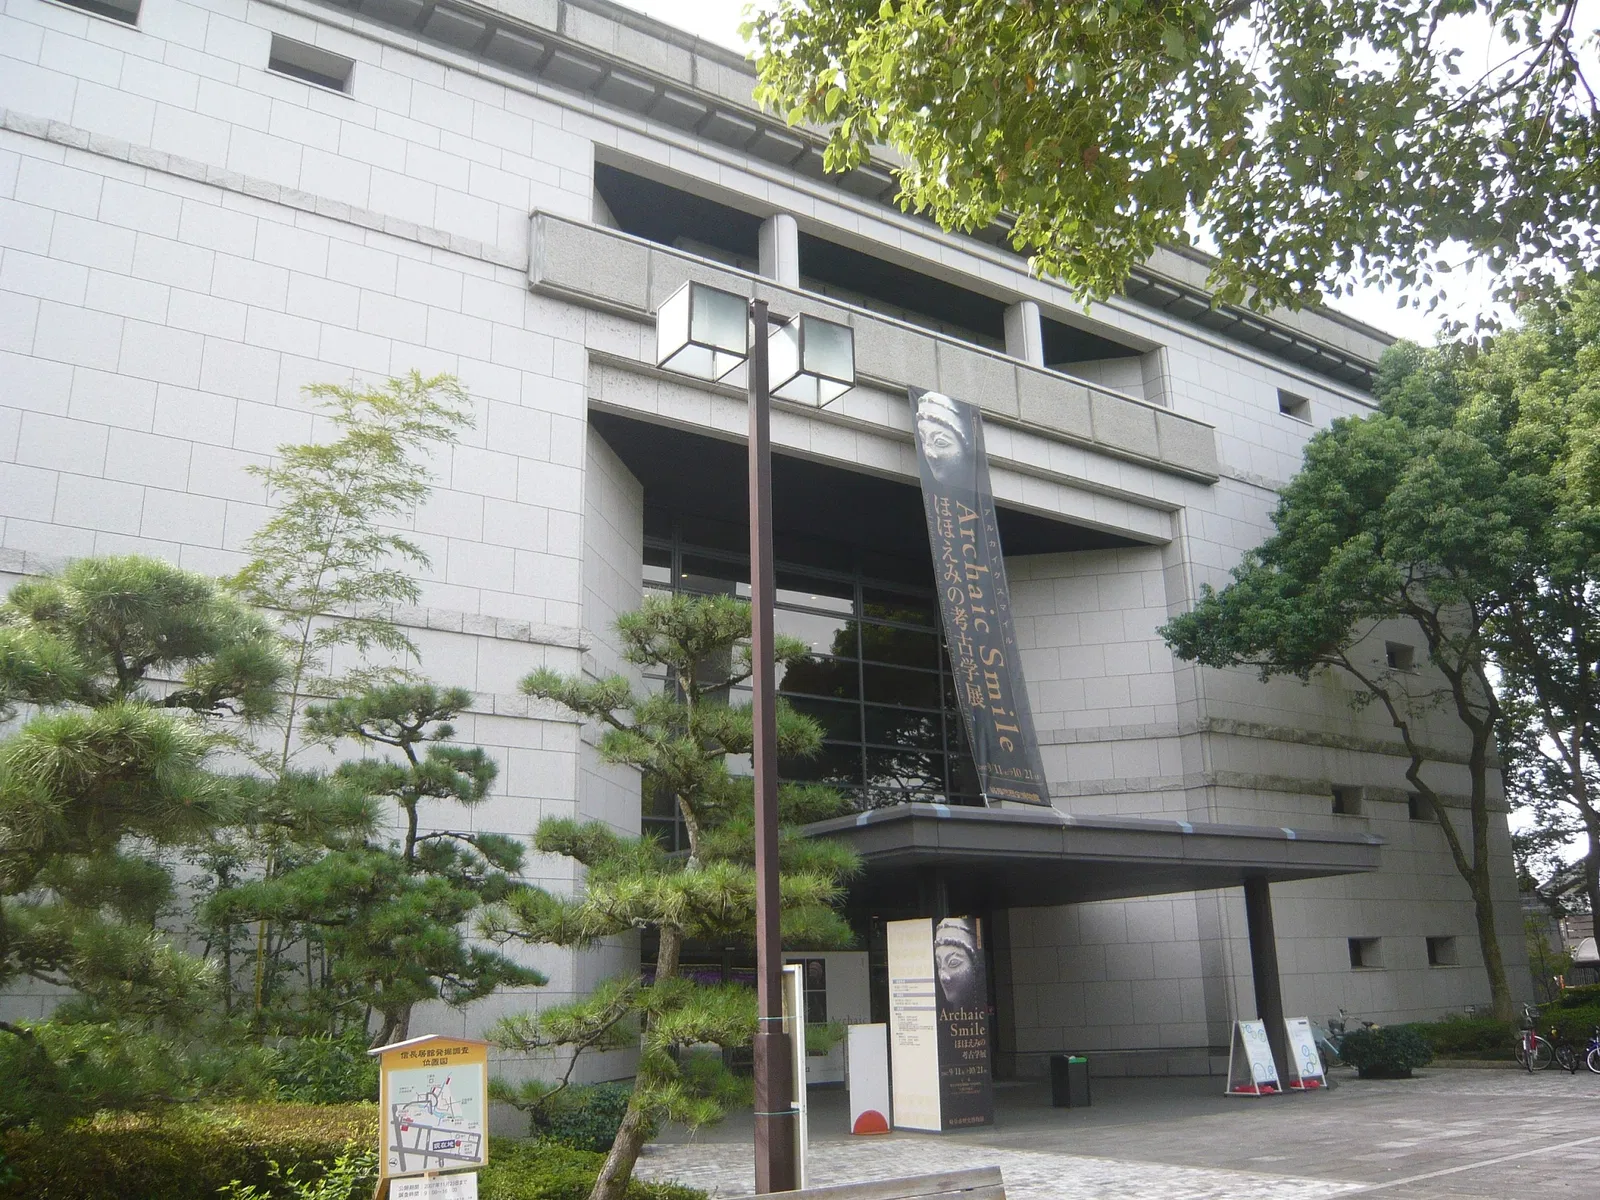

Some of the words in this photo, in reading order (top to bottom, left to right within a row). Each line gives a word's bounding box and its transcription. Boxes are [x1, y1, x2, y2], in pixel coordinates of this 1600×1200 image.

[934, 494, 986, 710] ほほえみの考古学展
[956, 500, 995, 635] Archaic
[979, 645, 1020, 753] Smile
[939, 1006, 985, 1021] Archaic
[950, 1022, 986, 1037] Smile
[954, 1039, 986, 1049] ほほえみの
[400, 1046, 469, 1059] 信長居館発掘調査
[962, 1050, 987, 1060] 考古学展
[422, 1057, 448, 1067] 位置図
